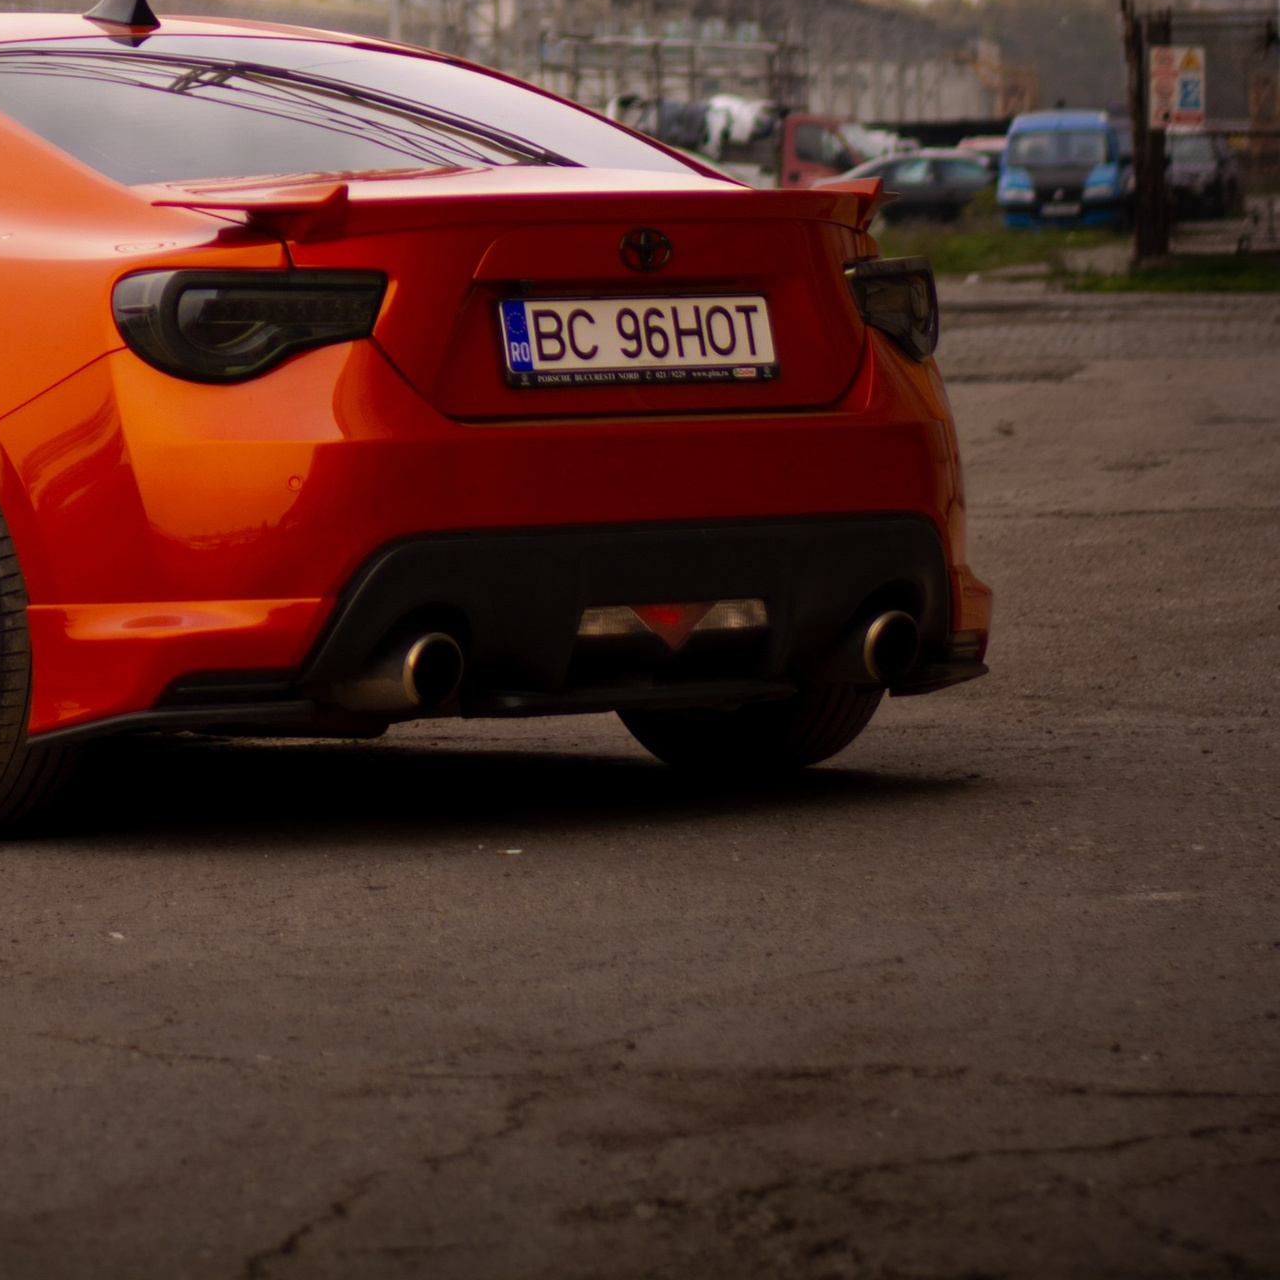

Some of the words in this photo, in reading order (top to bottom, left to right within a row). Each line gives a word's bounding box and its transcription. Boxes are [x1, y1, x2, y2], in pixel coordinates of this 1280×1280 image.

[531, 308, 599, 362] BC
[615, 304, 759, 359] 96HOT
[510, 341, 531, 363] RO
[537, 373, 572, 383] PORSCHE
[618, 371, 640, 380] NORD
